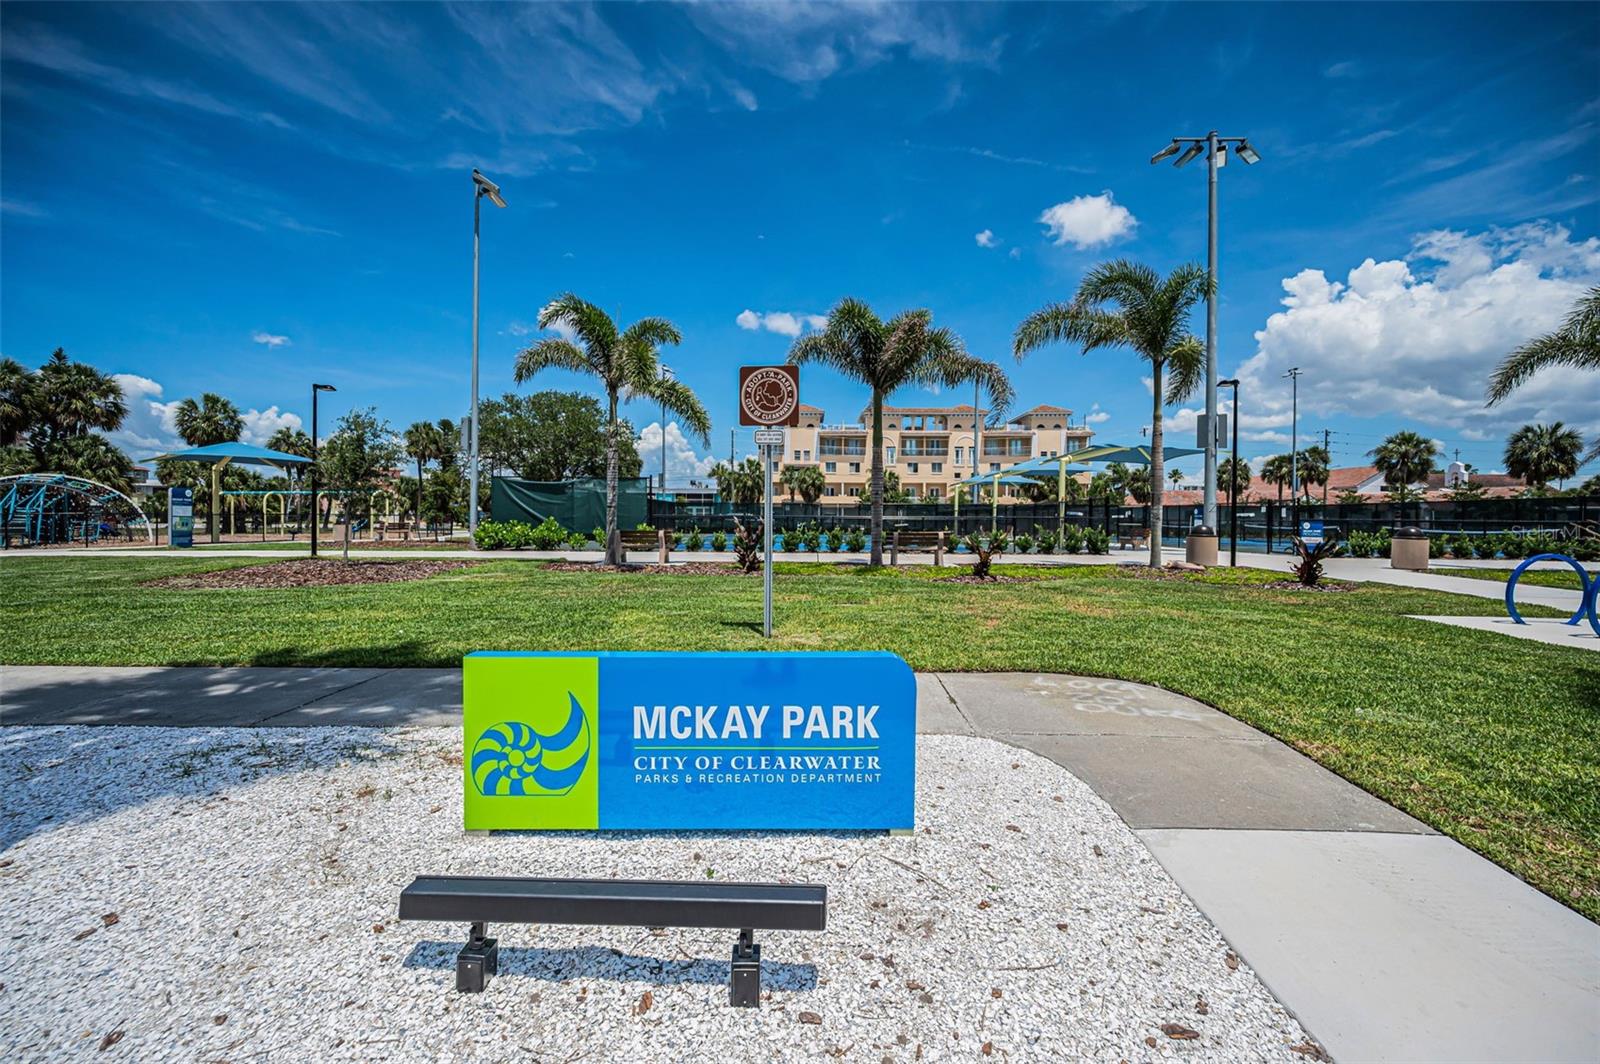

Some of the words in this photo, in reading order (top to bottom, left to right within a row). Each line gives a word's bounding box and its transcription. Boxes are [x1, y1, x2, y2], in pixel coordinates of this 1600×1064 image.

[745, 399, 755, 412] CITY
[762, 398, 792, 419] CLEARWATER
[633, 705, 769, 739] MCKAY
[783, 706, 880, 739] PARK
[633, 756, 687, 770] CITY
[695, 756, 722, 770] OF
[731, 756, 881, 770] CLEARWATER
[635, 773, 678, 783] PARKS
[685, 773, 692, 783] &
[699, 773, 784, 783] RECREATION
[791, 773, 881, 783] DEPARTMENT
